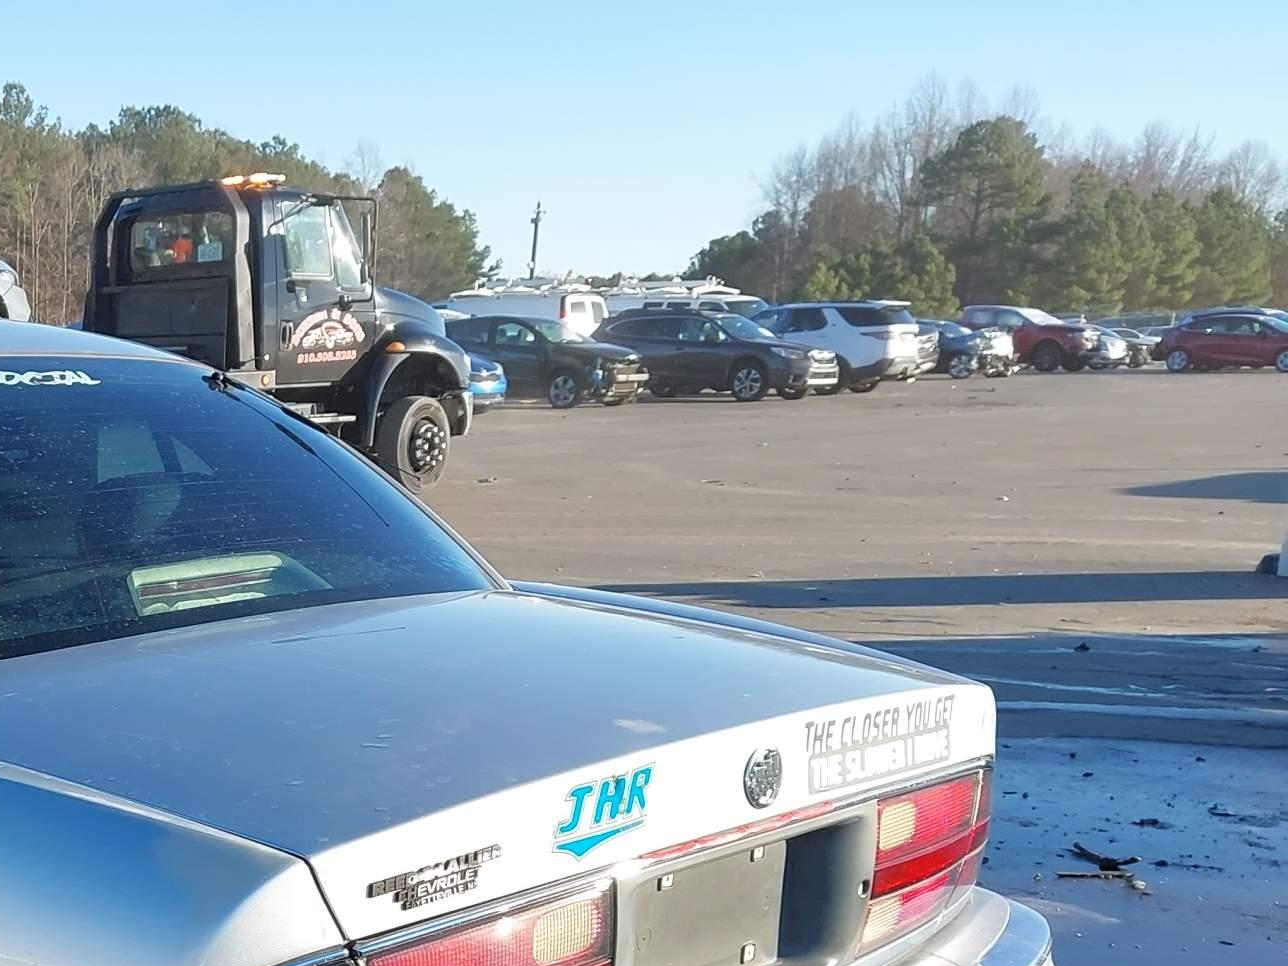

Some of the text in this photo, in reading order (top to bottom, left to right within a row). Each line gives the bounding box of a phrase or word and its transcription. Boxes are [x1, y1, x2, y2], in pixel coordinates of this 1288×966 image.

[804, 719, 836, 755] THE
[840, 706, 900, 747] CLOSER
[906, 699, 932, 733] YOU
[934, 694, 956, 727] GET
[556, 764, 654, 836] JHR
